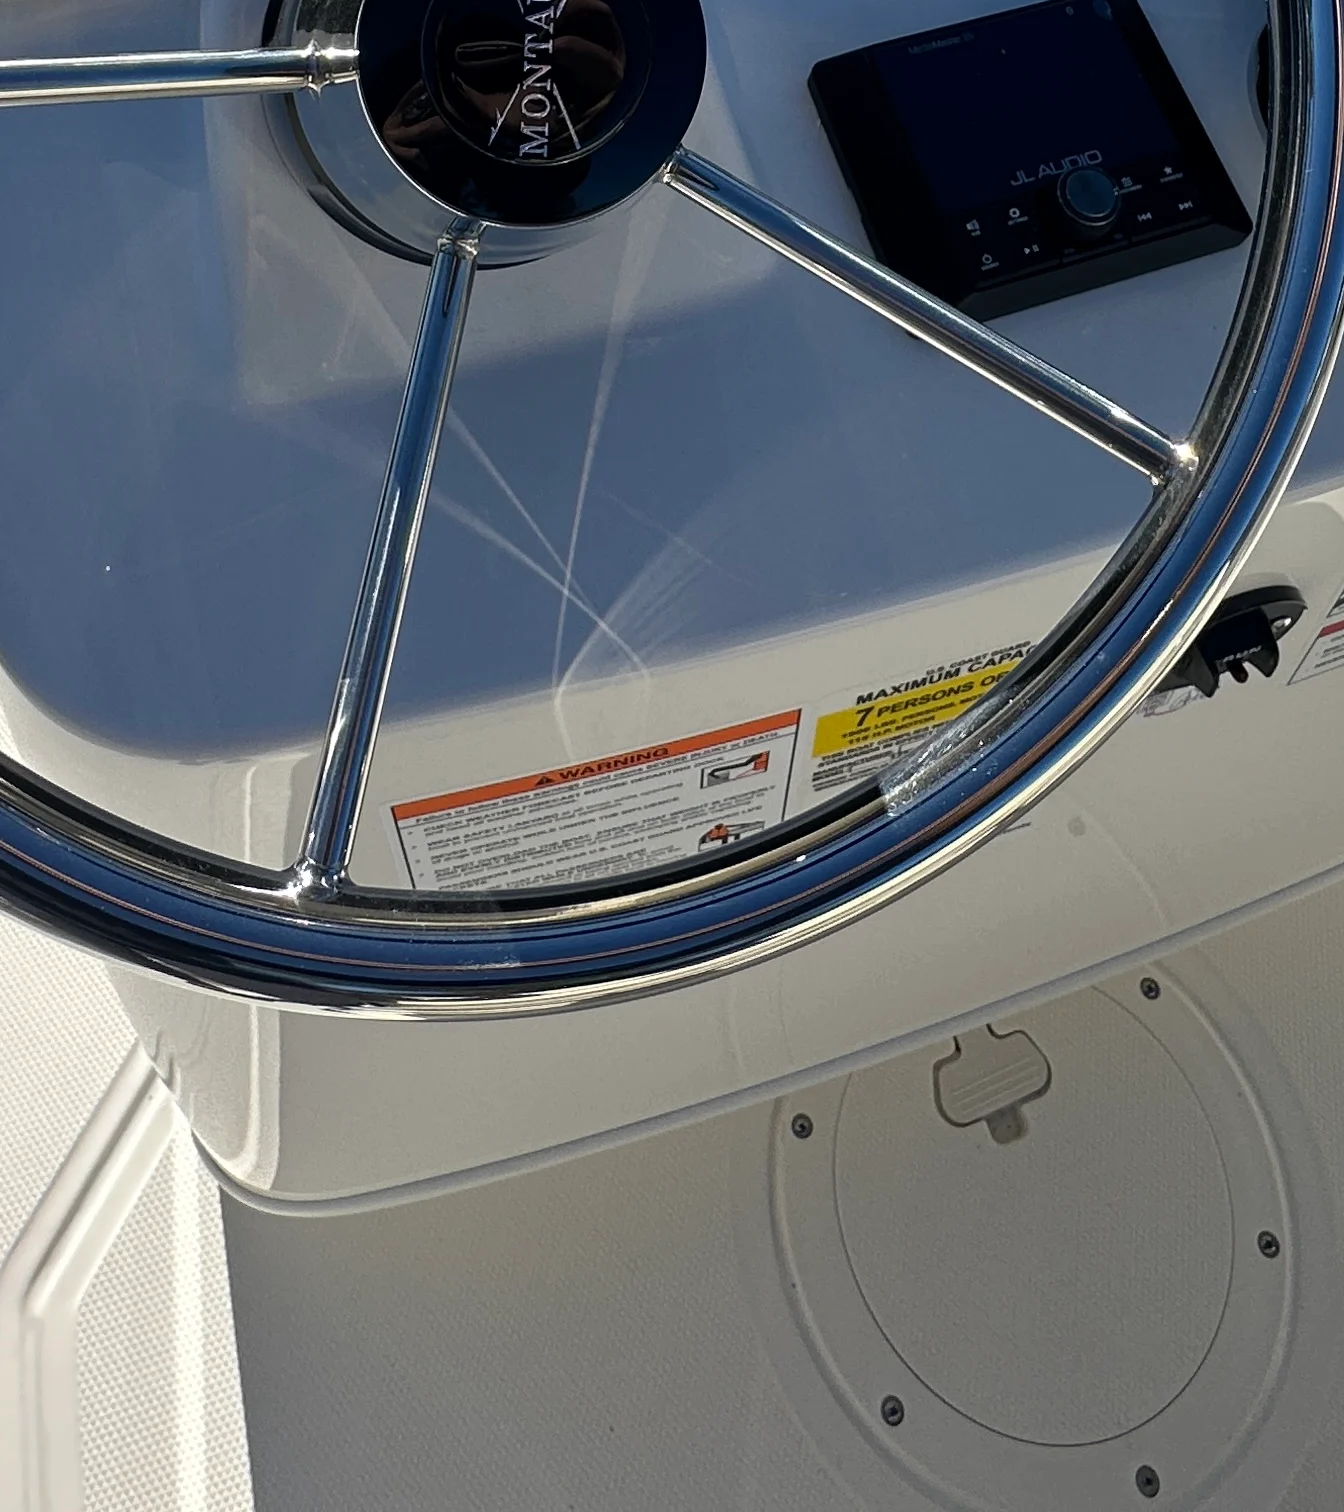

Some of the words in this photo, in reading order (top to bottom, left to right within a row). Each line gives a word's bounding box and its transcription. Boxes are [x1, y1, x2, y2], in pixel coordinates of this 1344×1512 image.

[1010, 169, 1036, 186] JL
[1038, 149, 1103, 179] AUDIO
[856, 667, 960, 705] MAXIMUM
[856, 705, 875, 727] 7
[877, 680, 975, 717] PERSONS
[559, 746, 668, 780] WARNING
